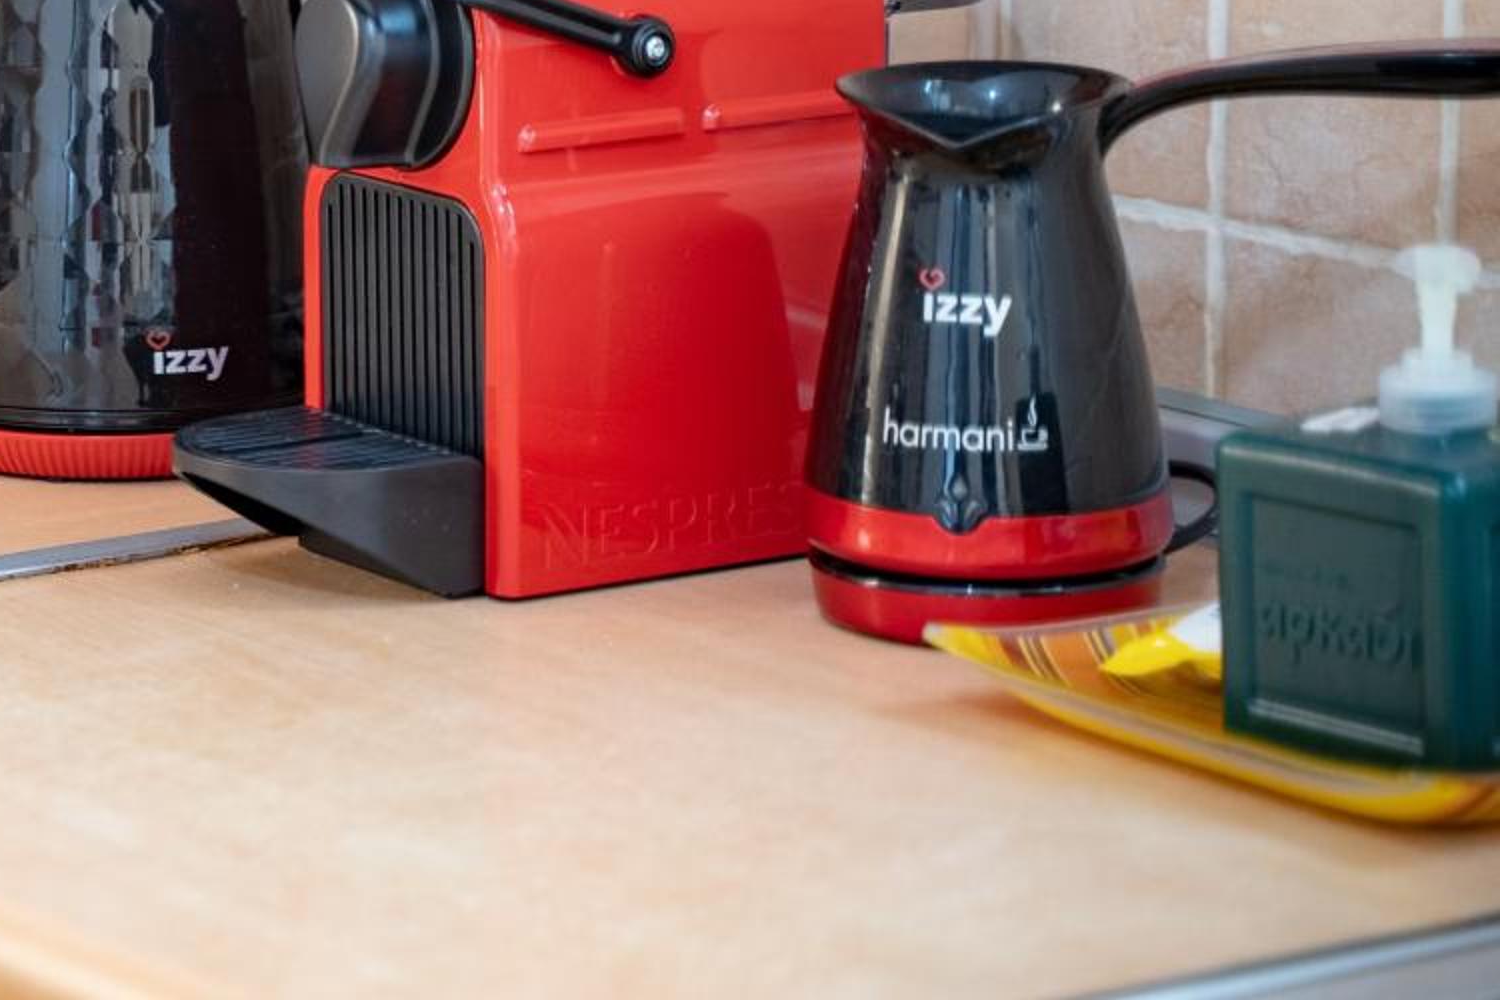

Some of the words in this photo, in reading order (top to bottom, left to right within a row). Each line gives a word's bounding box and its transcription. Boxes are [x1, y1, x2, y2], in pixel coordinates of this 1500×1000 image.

[923, 291, 1013, 338] izzy
[152, 345, 229, 381] izzy
[882, 406, 1014, 453] harmani
